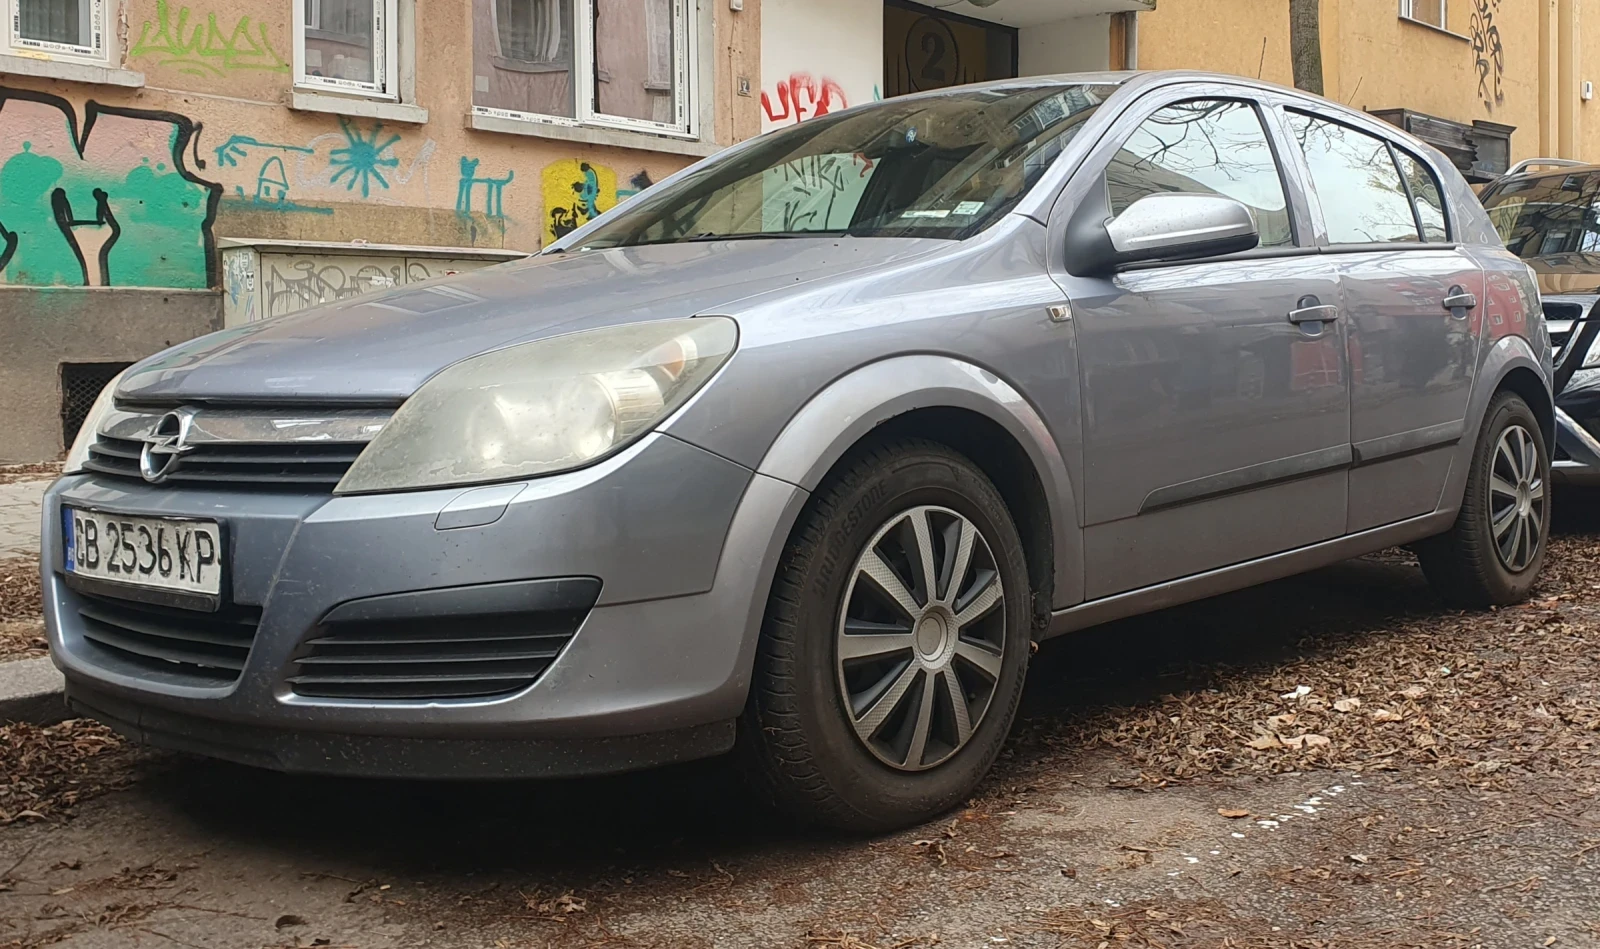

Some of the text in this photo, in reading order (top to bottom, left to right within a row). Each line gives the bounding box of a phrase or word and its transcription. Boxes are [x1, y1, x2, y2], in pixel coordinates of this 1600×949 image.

[921, 32, 946, 81] 2
[75, 516, 215, 584] CB 2536 KP
[813, 479, 890, 597] BRIDGESTONE
